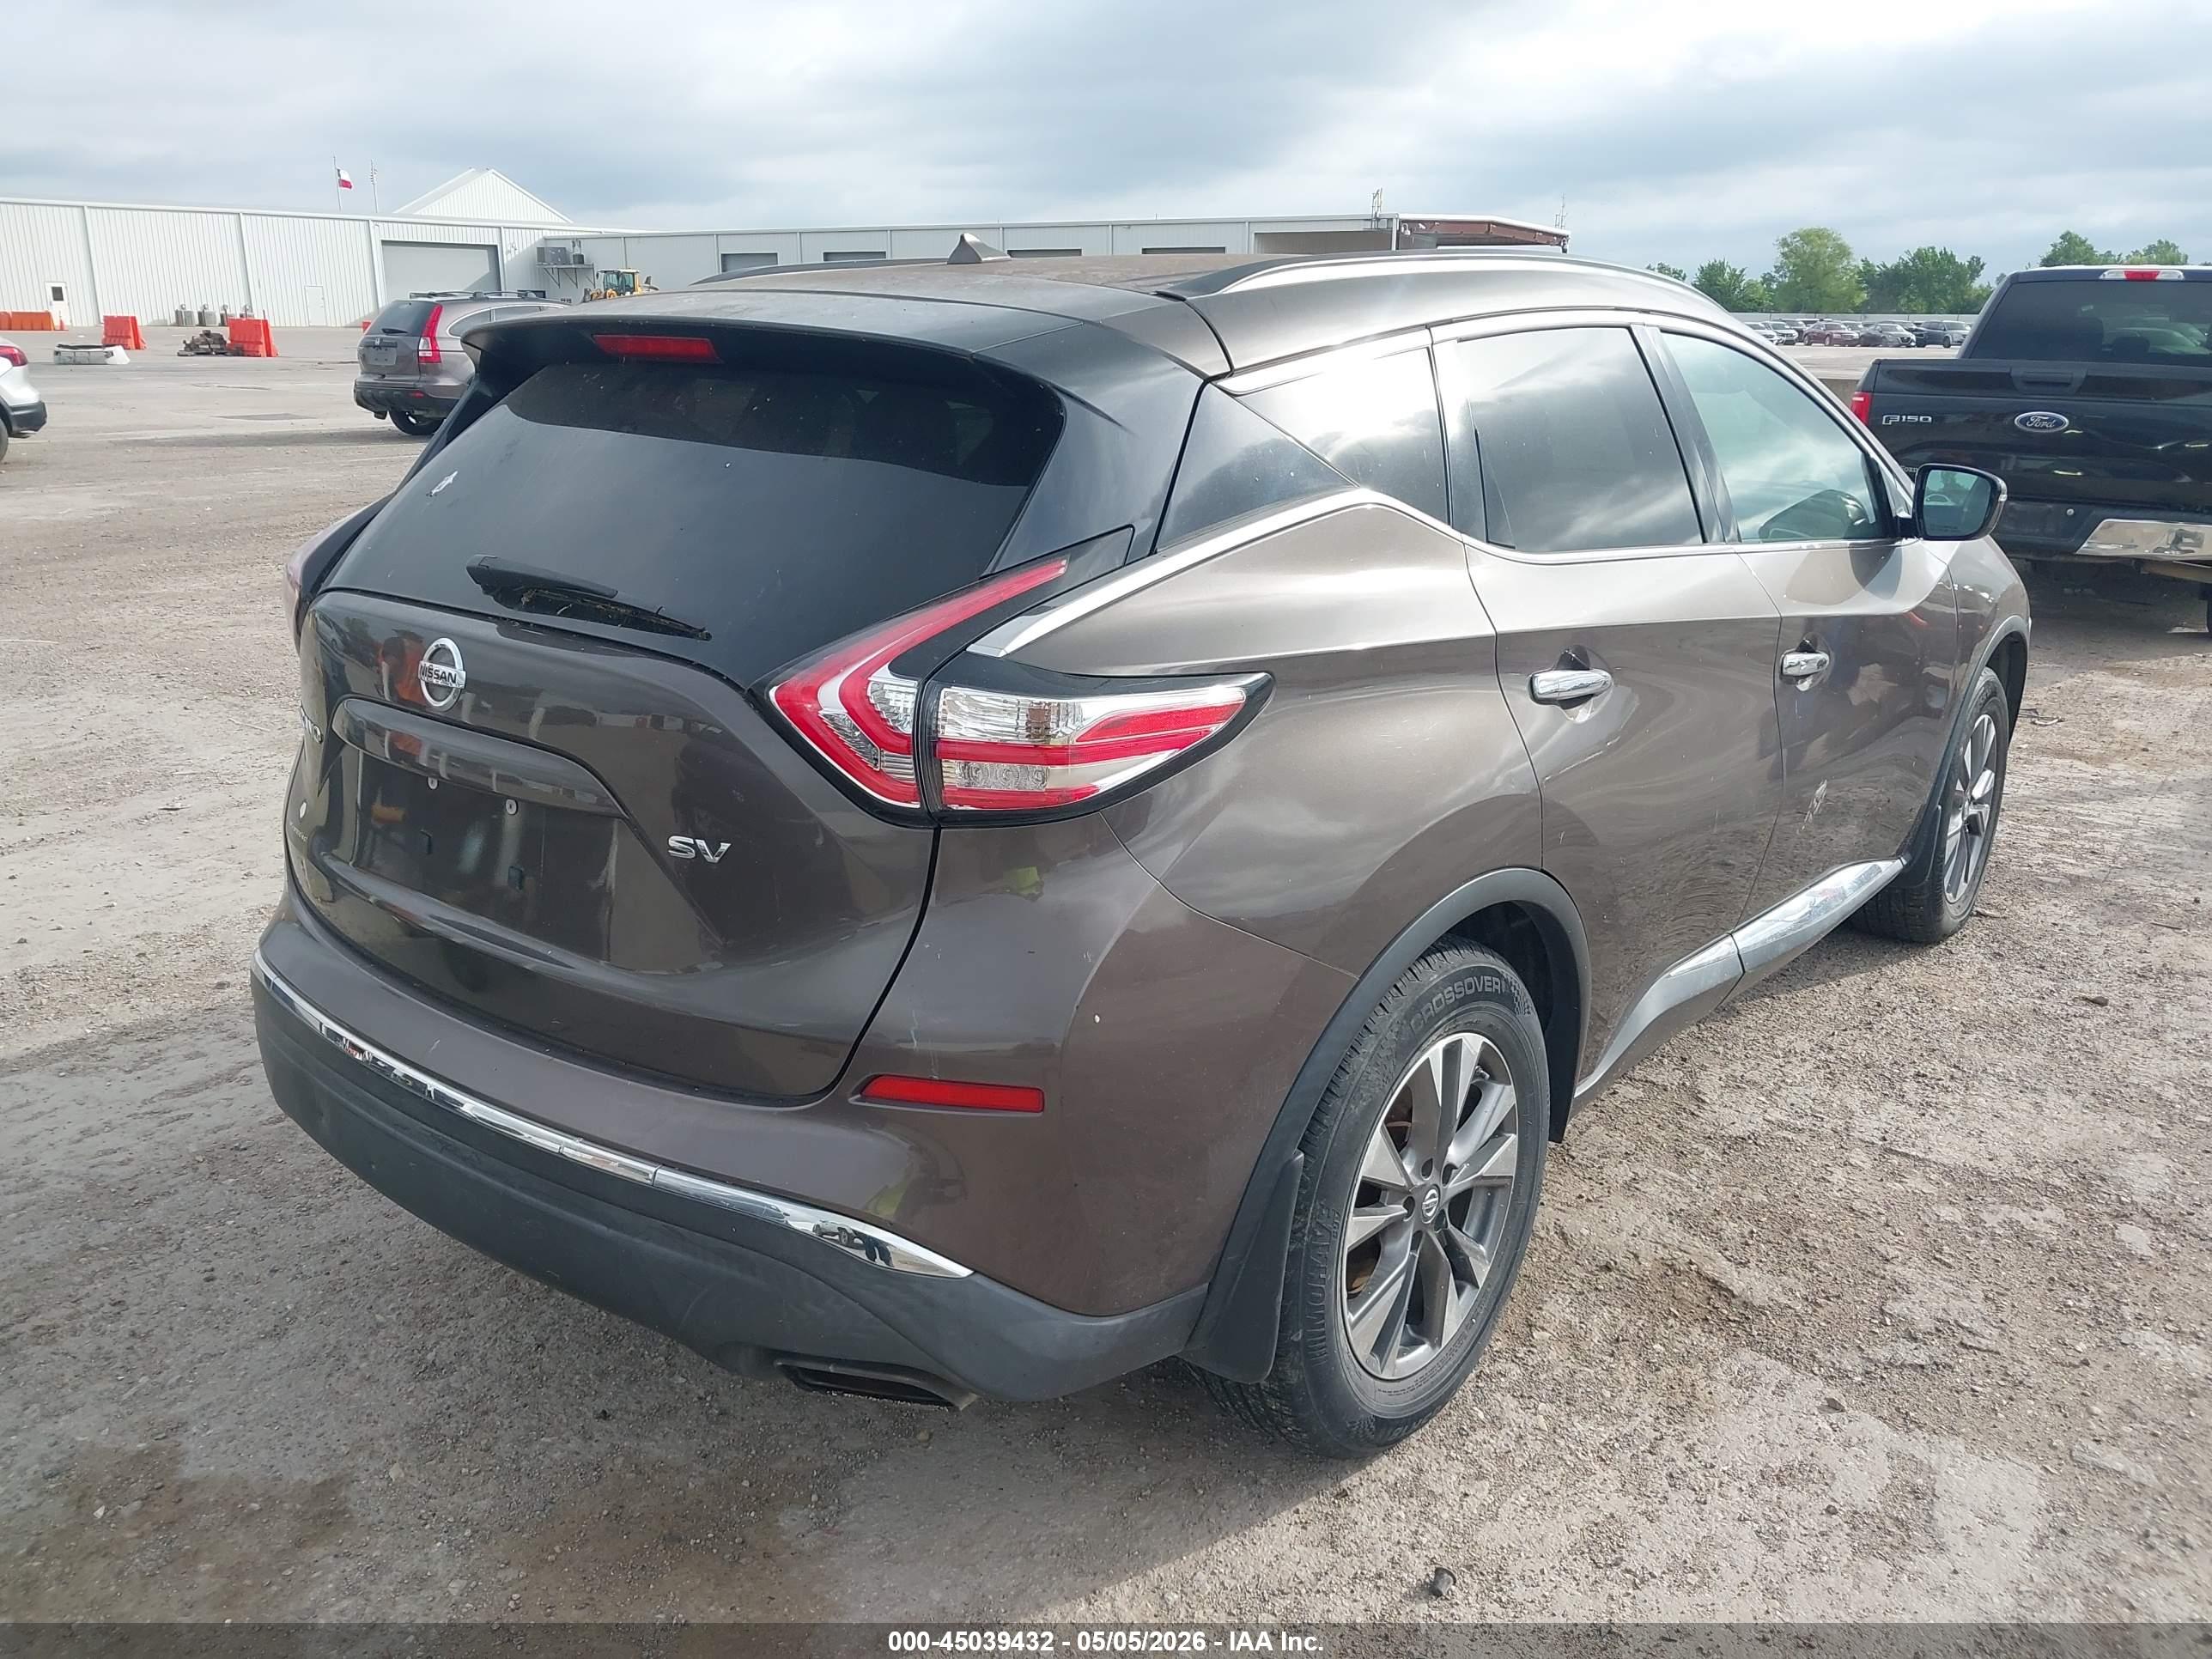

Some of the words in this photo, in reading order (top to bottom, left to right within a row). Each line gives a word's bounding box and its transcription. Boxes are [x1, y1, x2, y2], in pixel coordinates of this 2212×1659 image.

[2026, 416, 2056, 428] Ford
[419, 664, 457, 684] NISSAN
[668, 836, 731, 863] SV
[1410, 975, 1501, 1032] CROSSOVER
